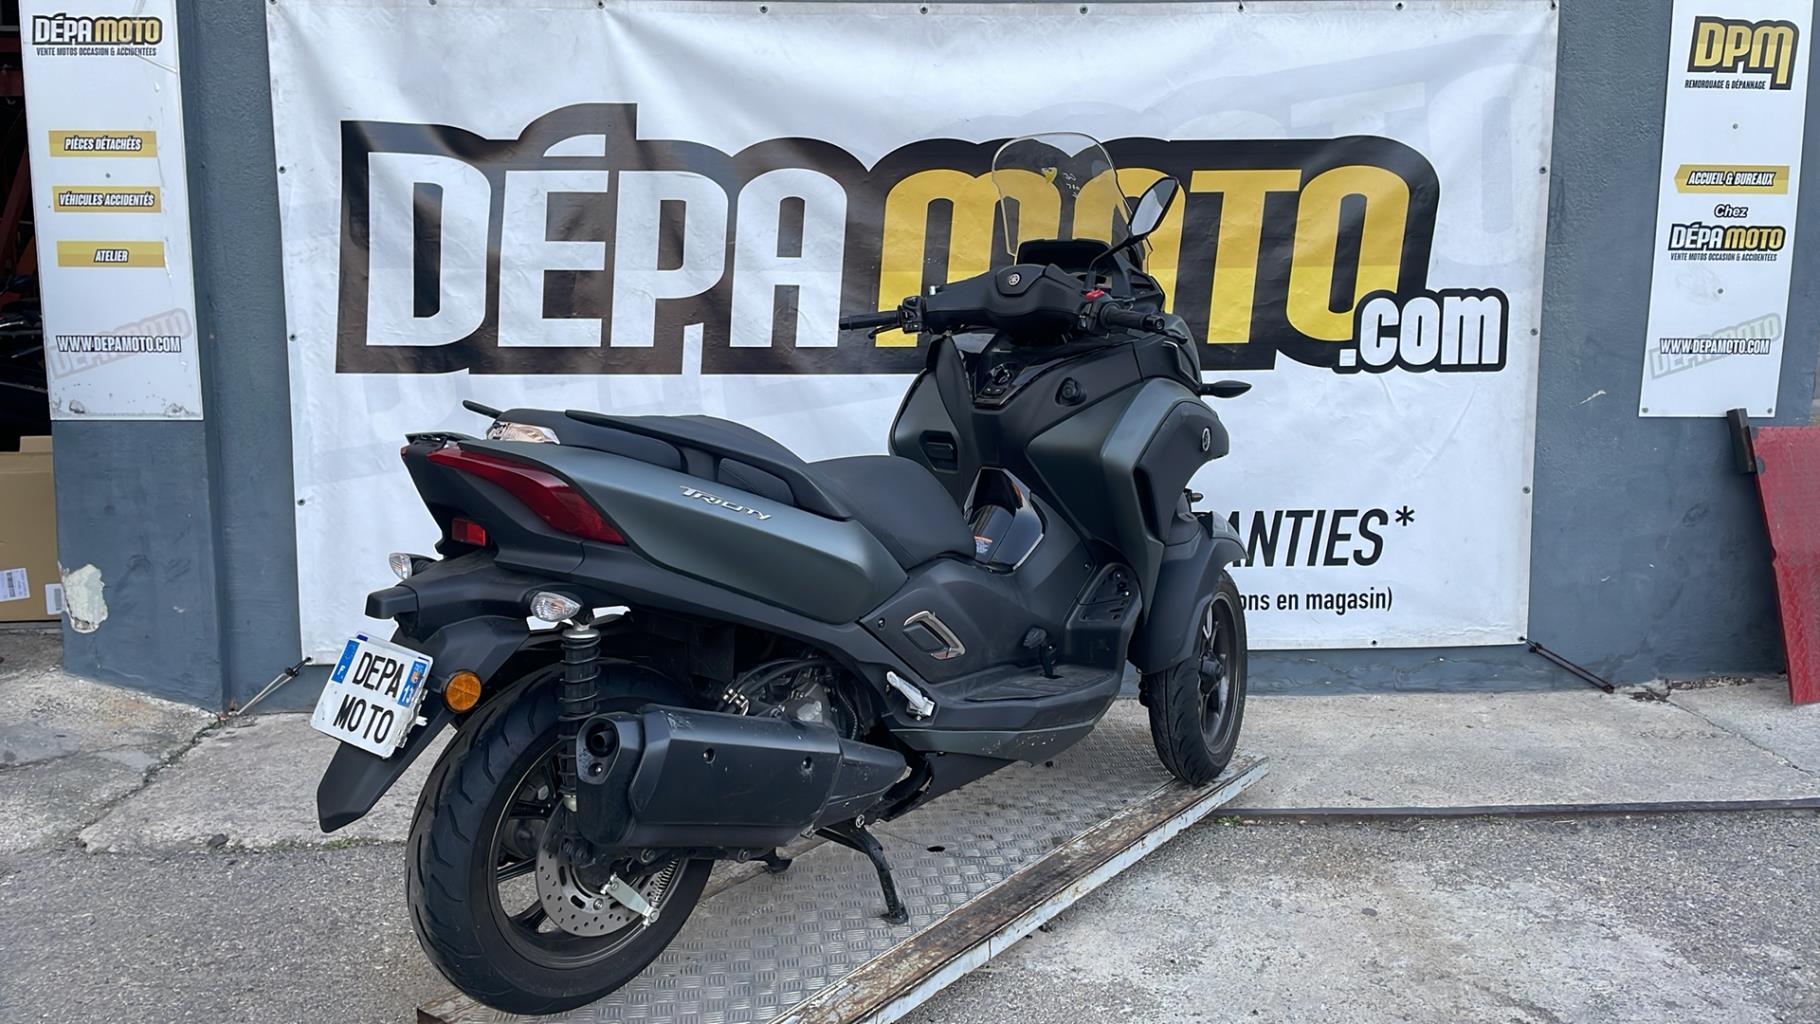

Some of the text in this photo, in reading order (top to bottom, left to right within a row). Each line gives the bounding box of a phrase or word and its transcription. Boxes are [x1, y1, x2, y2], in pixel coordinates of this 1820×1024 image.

[36, 46, 157, 56] VENTE MOTOS OCCASION & ACCIDENTÉES
[1687, 16, 1799, 90] DPM
[1685, 79, 1766, 89] REMORQUAGE & DÉPANNAGE
[65, 137, 142, 151] PIÈCES DÉTACHÉES
[1687, 171, 1776, 186] ACCUEIL & BUREAUX
[59, 192, 155, 207] VÉHICULES ACCIDENTÉS
[1714, 204, 1748, 218] Chez
[94, 249, 129, 263] ATELIER
[1670, 252, 1687, 261] VENTE
[1688, 252, 1707, 261] MOTOS
[1708, 252, 1736, 261] OCCASION
[1741, 252, 1778, 262] ACCIDENTÉES
[56, 335, 182, 352] WWW.DEPAMOTO.COM
[1660, 338, 1771, 354] WWW.DEPAMOTO.COM
[1277, 593, 1299, 610] en
[1306, 587, 1393, 616] magasin)
[352, 652, 405, 698] DEPA
